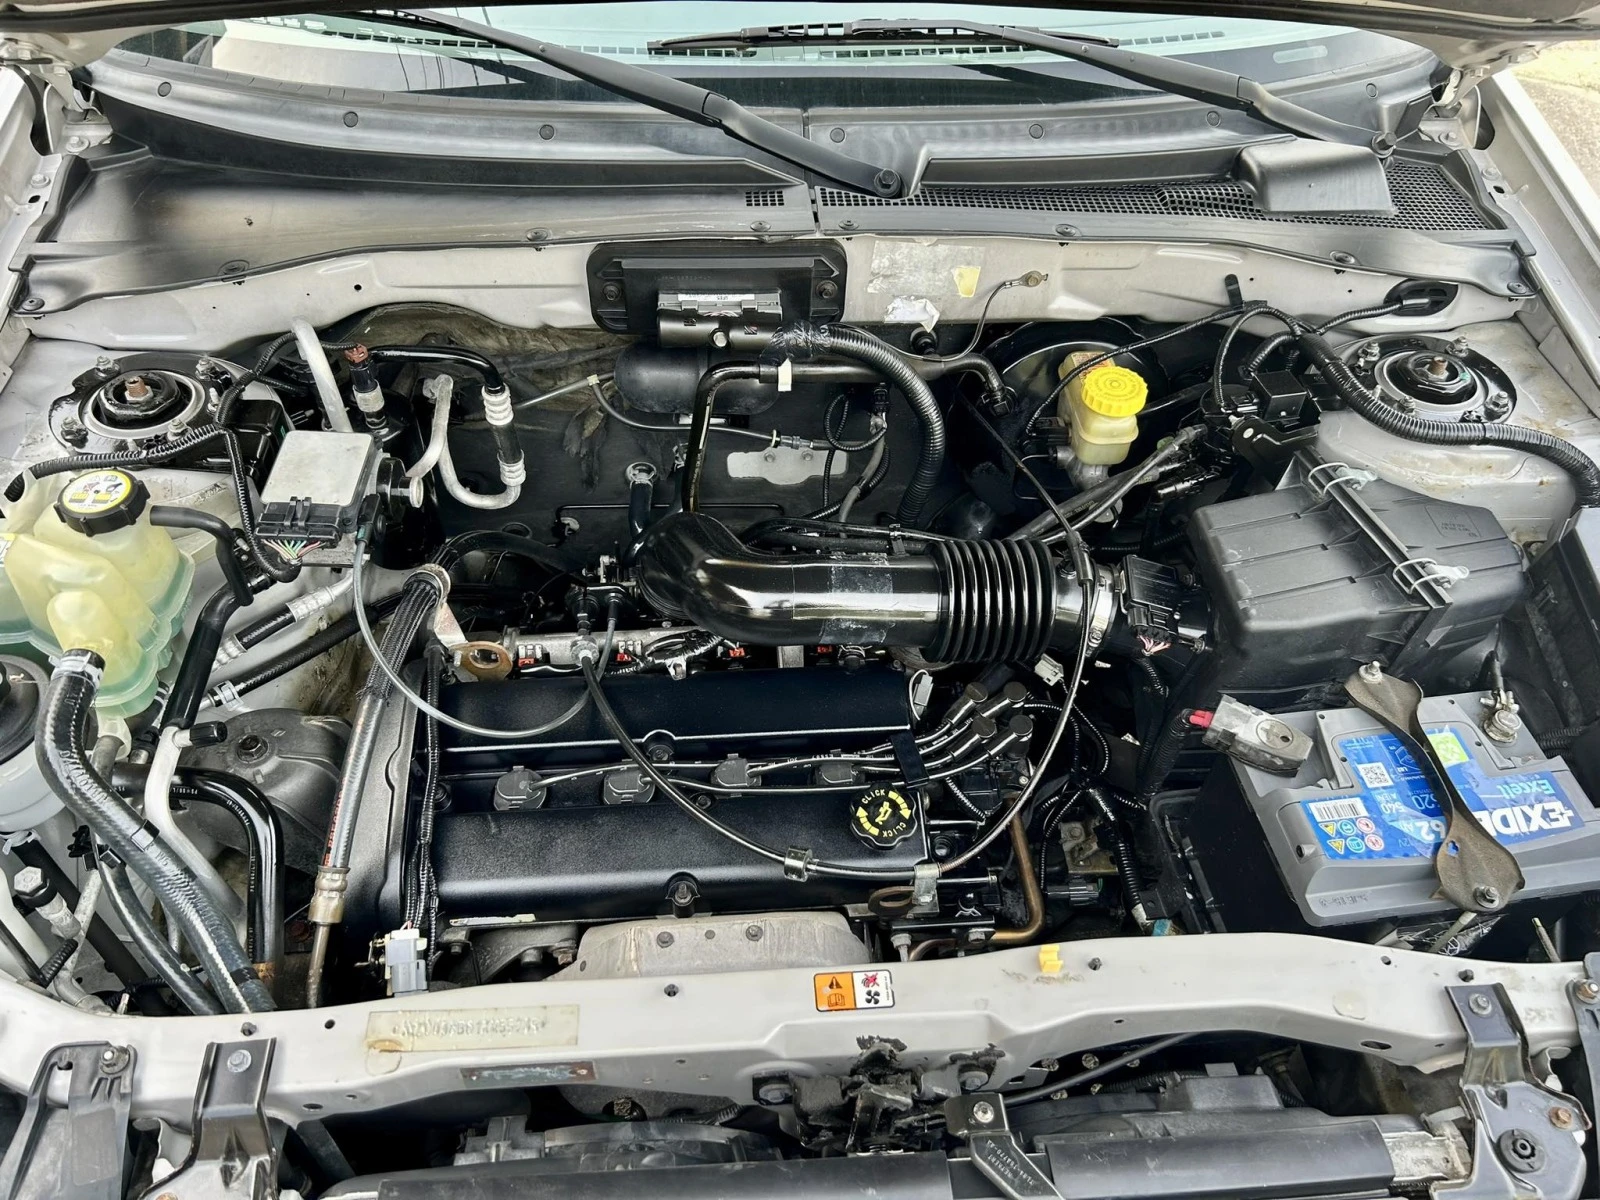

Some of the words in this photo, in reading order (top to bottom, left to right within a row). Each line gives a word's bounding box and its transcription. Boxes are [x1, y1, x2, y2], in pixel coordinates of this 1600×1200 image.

[861, 789, 886, 804] CLICK
[1497, 779, 1556, 800] Excell
[1381, 802, 1407, 814] 540
[882, 821, 907, 838] CLICK
[1415, 820, 1446, 841] 62
